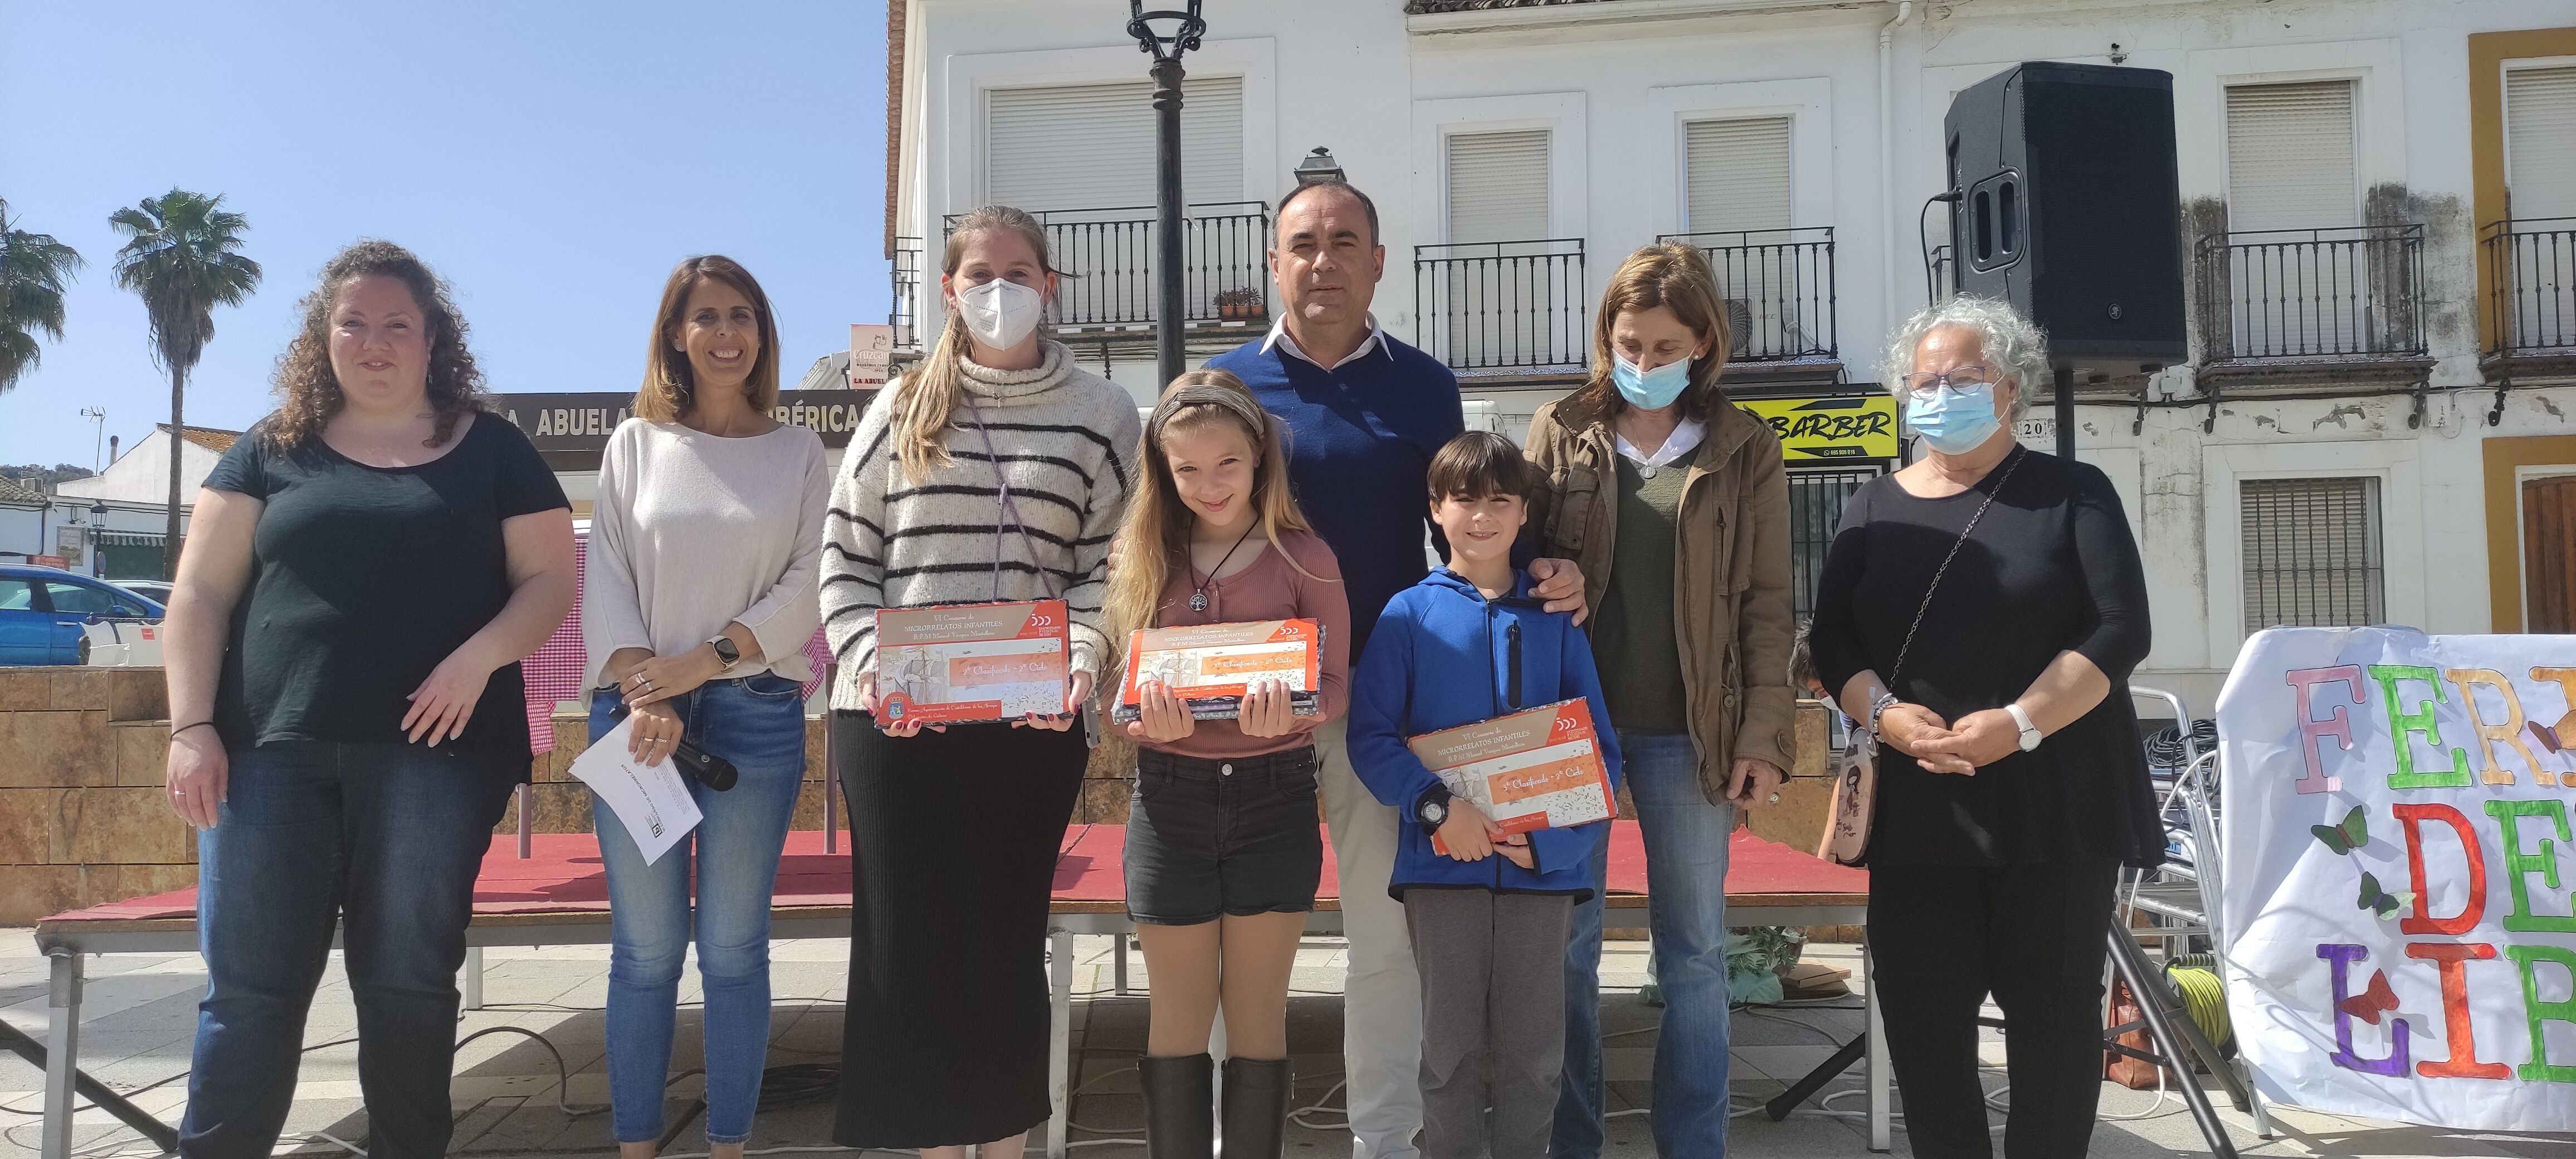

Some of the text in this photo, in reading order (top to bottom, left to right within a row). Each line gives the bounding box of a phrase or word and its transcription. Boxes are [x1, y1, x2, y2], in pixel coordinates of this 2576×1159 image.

[508, 409, 521, 428] A
[1767, 411, 1892, 441] BARBER
[2023, 423, 2043, 435] 20
[905, 620, 1003, 632] MICRORRELATOS INFANTILES
[973, 664, 1011, 676] Clasificado
[1029, 661, 1048, 671] Ciclo
[1223, 659, 1258, 668] Clasificado
[1437, 738, 1492, 756] MICRORRELATOS
[1494, 729, 1530, 743] INFANTILES
[1512, 773, 1549, 788] Clasificado
[1565, 766, 1584, 777] Ciclo
